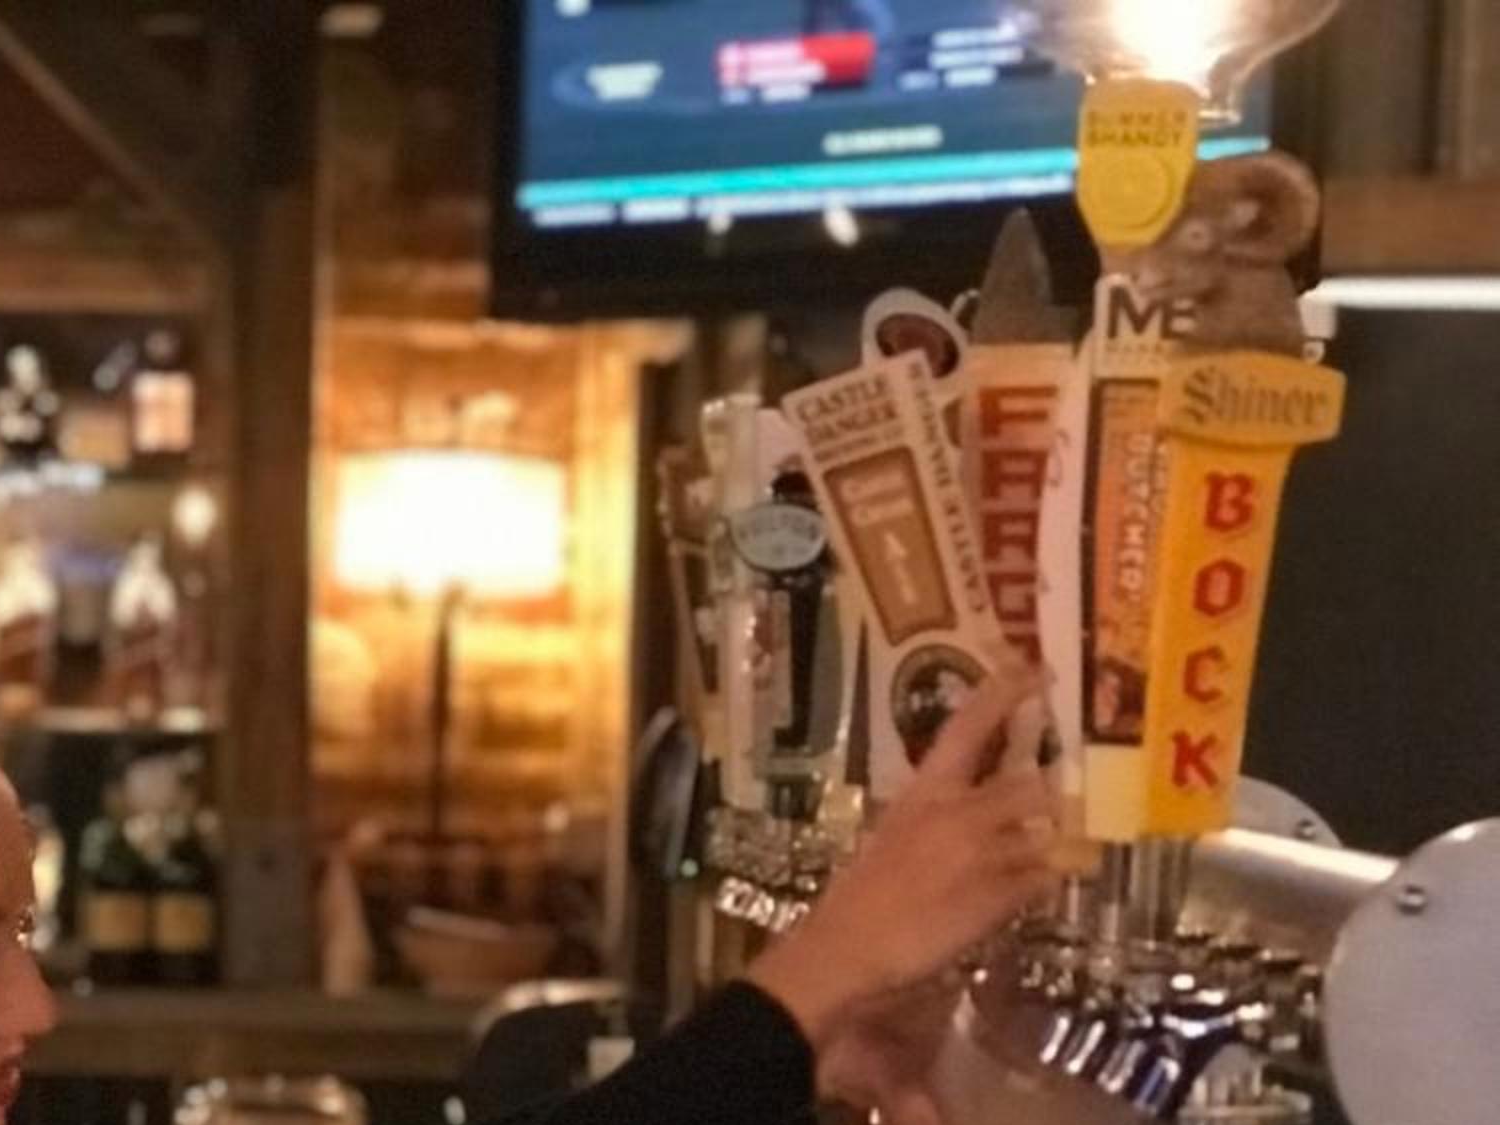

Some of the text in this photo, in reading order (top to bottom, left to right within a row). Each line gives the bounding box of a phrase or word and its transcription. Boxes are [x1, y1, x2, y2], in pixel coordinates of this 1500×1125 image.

[1087, 129, 1183, 148] SHANDY
[1182, 365, 1329, 426] Shiner
[1171, 472, 1254, 789] BOCK
